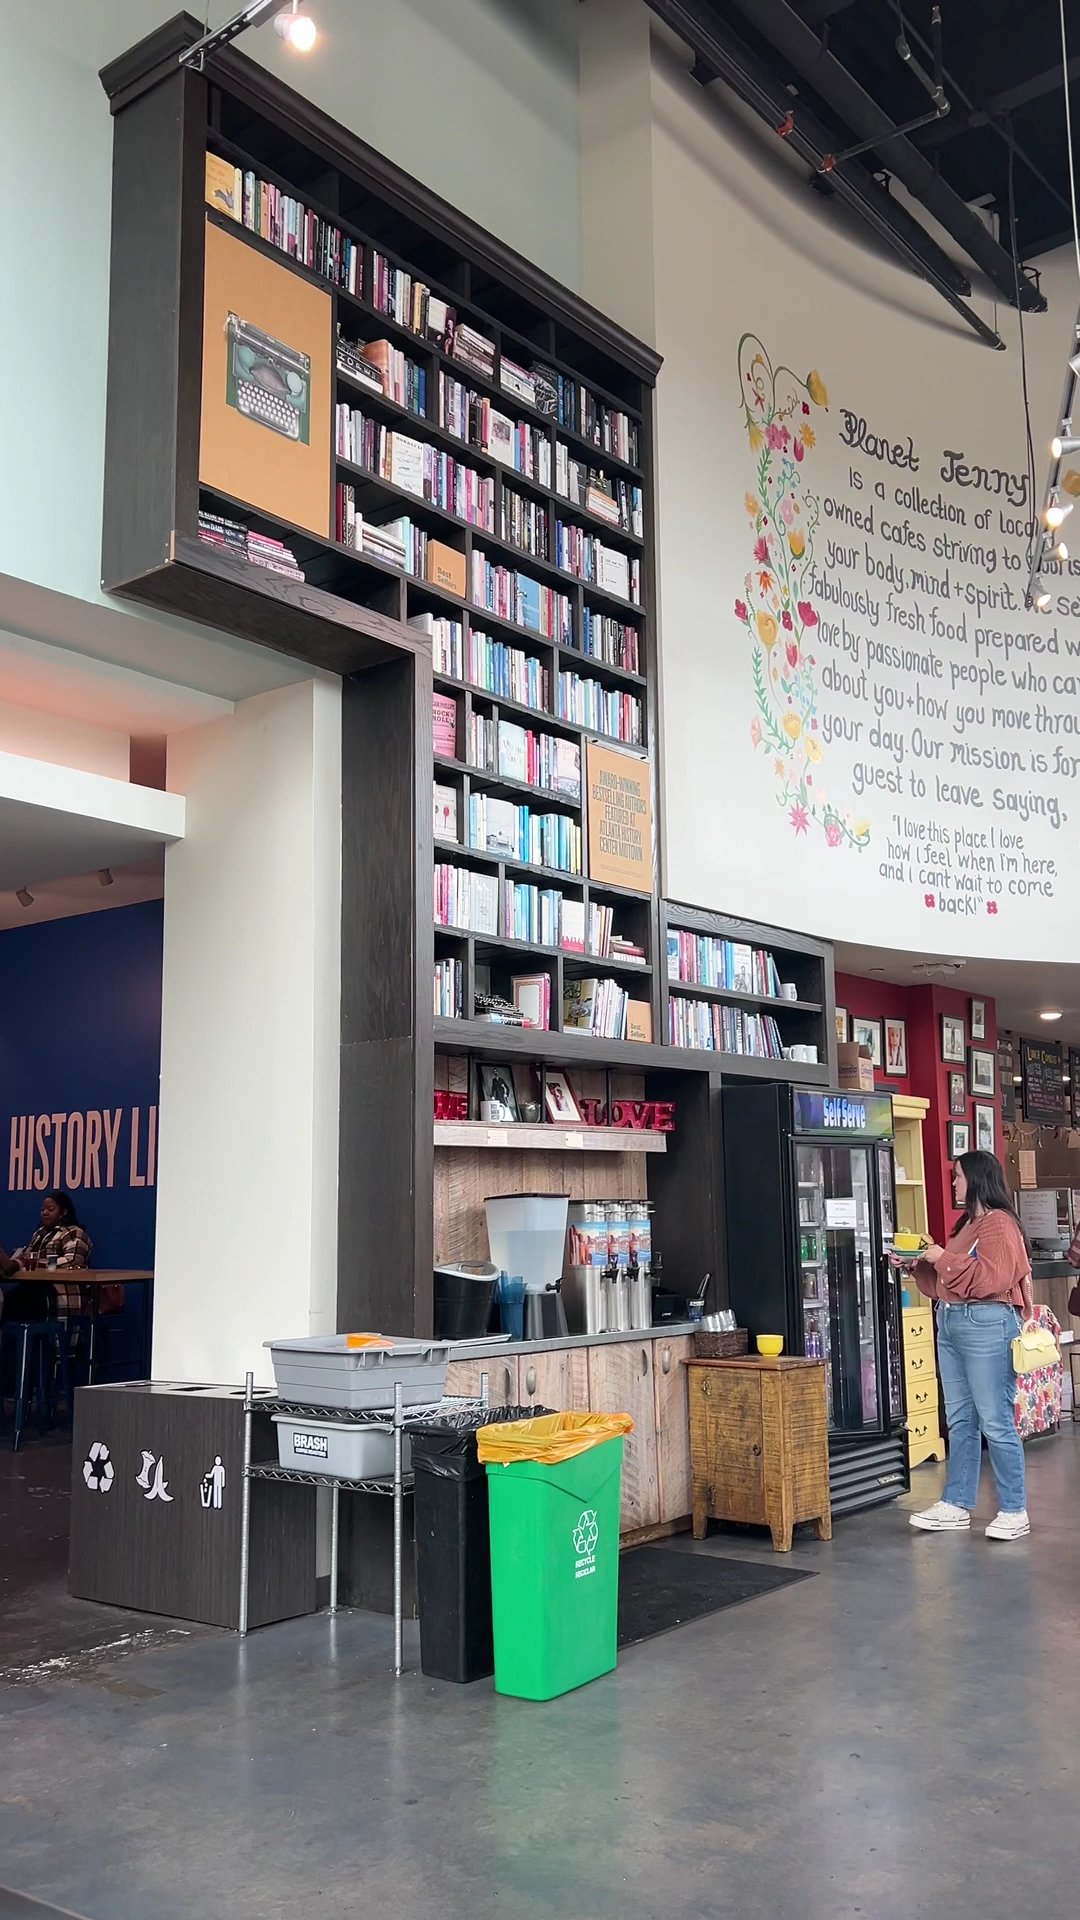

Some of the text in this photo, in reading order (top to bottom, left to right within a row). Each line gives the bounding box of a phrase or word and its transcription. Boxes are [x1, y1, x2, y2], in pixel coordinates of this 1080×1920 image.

[839, 408, 1030, 507] Planet Jenny
[849, 466, 863, 491] Is
[874, 482, 885, 501] a
[894, 486, 967, 526] collection
[974, 508, 992, 530] of
[823, 497, 874, 536] owned
[881, 519, 926, 552] cafes
[933, 532, 997, 574] striving
[1001, 545, 1021, 571] to
[437, 566, 452, 580] Best
[825, 538, 860, 569] your
[865, 541, 909, 594] body,
[910, 567, 951, 600] mind
[808, 560, 880, 627] fabulously
[885, 592, 926, 635] fresh
[929, 606, 967, 644] food
[974, 628, 1060, 661] prepared
[816, 610, 840, 648] love
[842, 618, 861, 663] by
[865, 637, 943, 679] passionate
[950, 659, 1007, 696] people
[1011, 661, 1047, 693] who
[822, 658, 868, 701] about
[874, 682, 904, 717] you
[916, 682, 949, 720] how
[953, 705, 985, 734] you
[992, 707, 1032, 730] move
[822, 714, 1080, 778] your day. Our mission is for
[592, 783, 647, 815] BESTSELLING AUTHORS
[599, 769, 641, 797] AWARD-WINNING
[852, 762, 903, 796] guest
[909, 768, 926, 798] to
[935, 774, 984, 807] leave
[600, 819, 643, 845] ATLANTA HISTORY
[605, 804, 636, 828] FEATURED AT
[600, 836, 643, 862] CENTER MIDTOWN
[904, 817, 925, 840] love
[926, 820, 950, 844] this
[954, 825, 989, 853] place.
[990, 826, 995, 849] I
[999, 828, 1024, 850] love
[886, 837, 1058, 878] how I feel when I'm here,
[879, 861, 904, 883] and
[909, 865, 913, 883] I
[954, 873, 983, 894] wait
[986, 876, 1003, 894] to
[1008, 879, 1054, 898] come
[938, 891, 984, 916] back!"
[580, 1098, 675, 1131] LOVE
[823, 1097, 866, 1129] Self Serve
[8, 1108, 123, 1191] HISTORY
[294, 1433, 328, 1452] BRASH
[575, 1554, 596, 1569] RECYCLE
